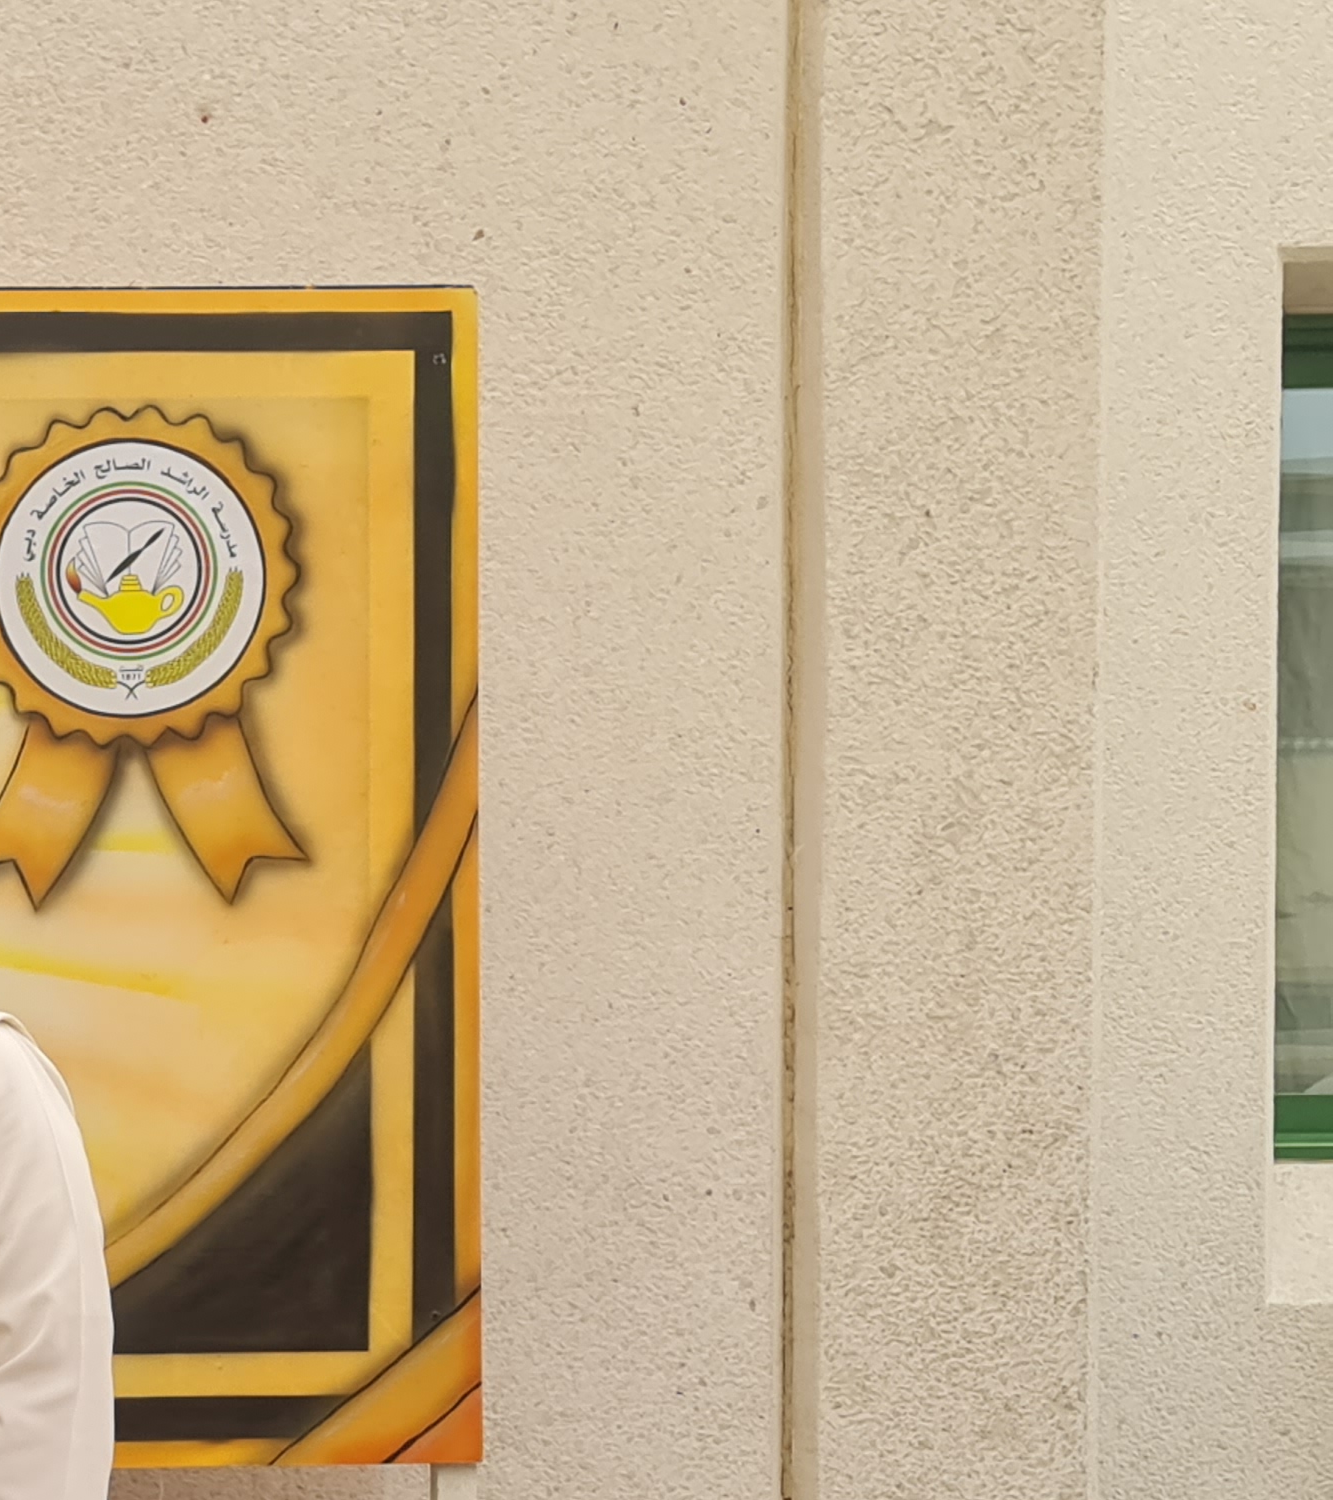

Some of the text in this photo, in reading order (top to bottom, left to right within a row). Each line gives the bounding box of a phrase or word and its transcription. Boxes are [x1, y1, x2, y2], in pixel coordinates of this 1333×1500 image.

[22, 456, 238, 562] مدرسة الراشد الصالح الخاصة دبي
